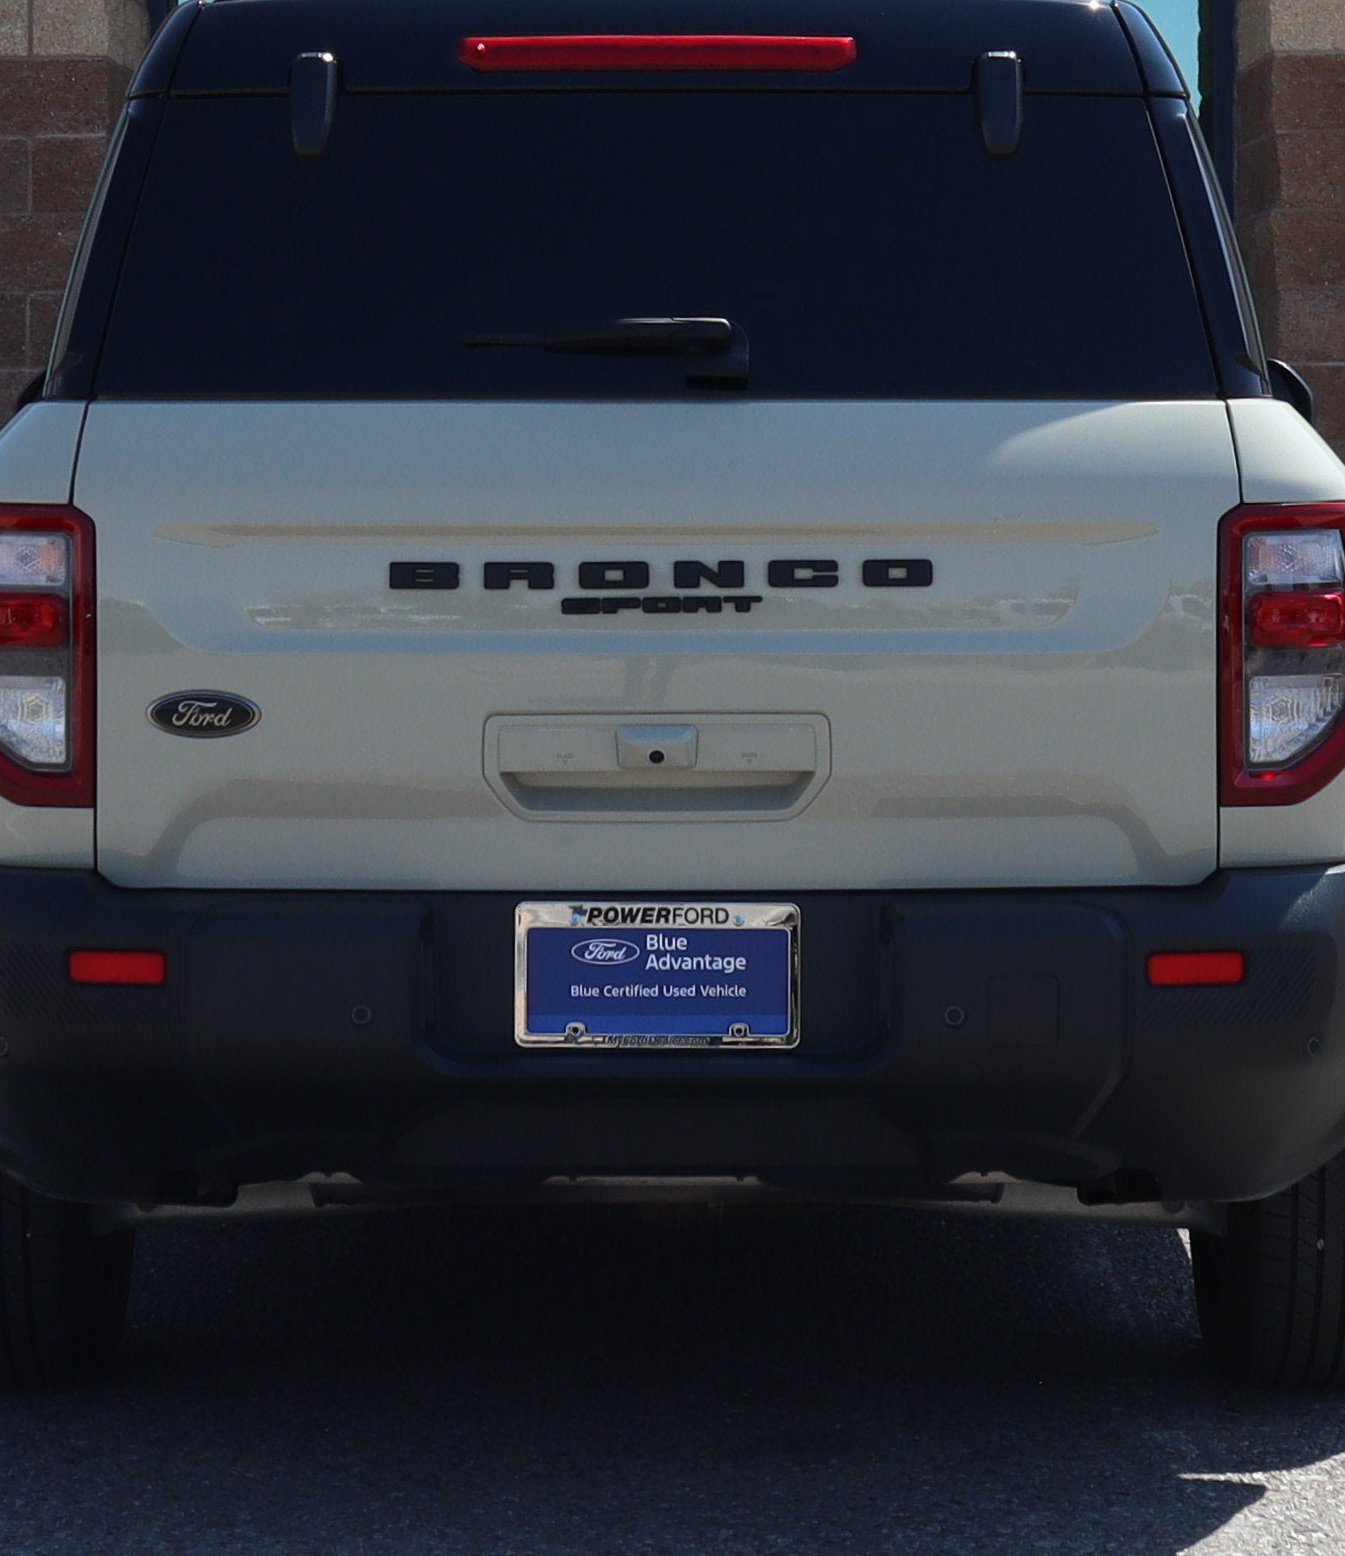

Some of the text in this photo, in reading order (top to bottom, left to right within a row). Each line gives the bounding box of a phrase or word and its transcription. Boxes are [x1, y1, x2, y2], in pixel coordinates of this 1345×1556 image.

[389, 559, 934, 590] BRONCO
[561, 595, 763, 615] SPORT
[172, 700, 232, 727] Ford
[587, 907, 729, 925] POWERFORD
[584, 942, 627, 961] Ford
[646, 934, 687, 950] Blue
[645, 954, 747, 974] Advantage
[571, 984, 747, 997] Blue Certified Used Vehicle
